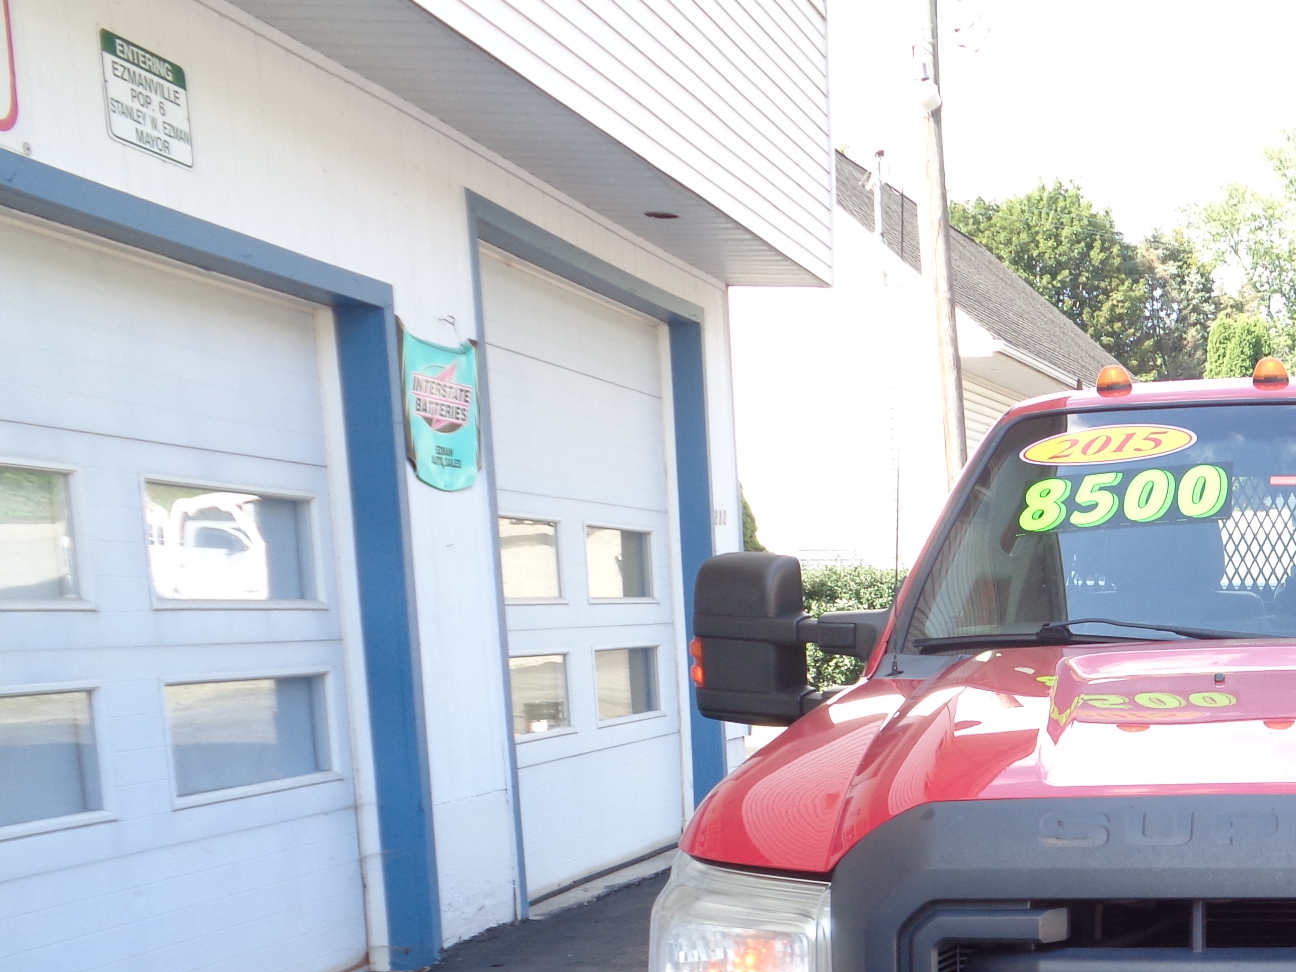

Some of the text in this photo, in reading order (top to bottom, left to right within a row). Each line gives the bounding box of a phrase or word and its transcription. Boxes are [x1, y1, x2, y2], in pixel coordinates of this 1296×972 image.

[115, 38, 173, 80] ENTERING
[111, 60, 181, 107] EZMANVILLE
[131, 88, 166, 116] POP. 6
[110, 97, 191, 145] STANLEY W. EZMAN
[135, 127, 171, 155] MAYOR
[413, 376, 470, 404] INTERSTATE
[415, 397, 467, 422] BATTERIES
[1047, 431, 1169, 460] 2015
[1018, 464, 1229, 532] 8500
